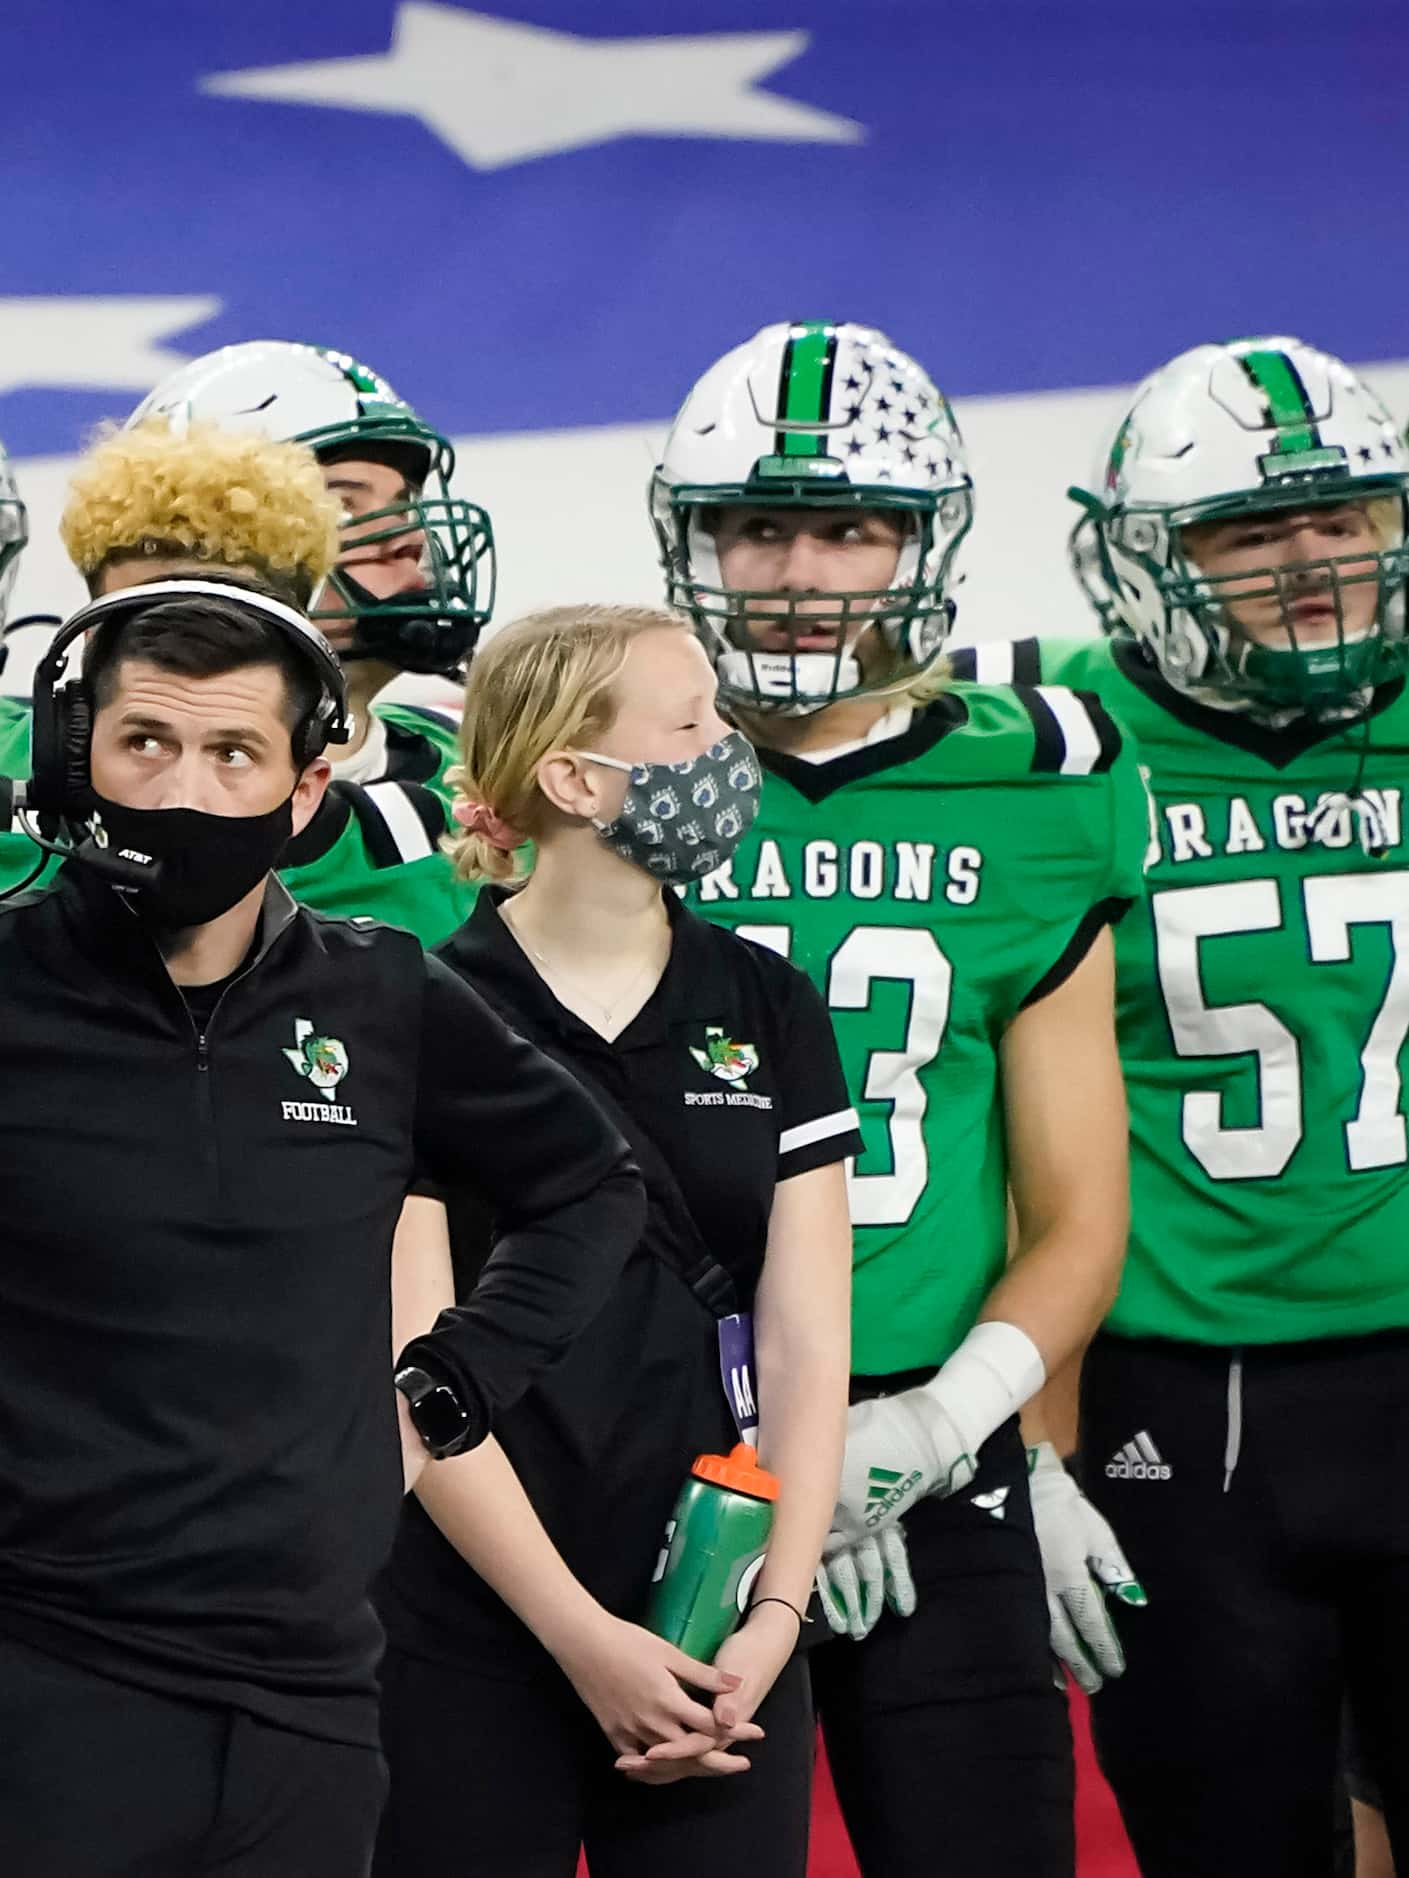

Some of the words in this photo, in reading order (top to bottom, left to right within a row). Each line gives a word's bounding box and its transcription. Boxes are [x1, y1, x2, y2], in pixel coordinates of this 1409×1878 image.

[676, 839, 982, 905] RAGONS
[1150, 877, 1409, 1181] 57
[281, 1101, 358, 1125] FOOTBALL
[684, 1092, 724, 1106] SPORTS
[725, 1093, 773, 1110] MEDICINE
[1104, 1461, 1172, 1481] adidas
